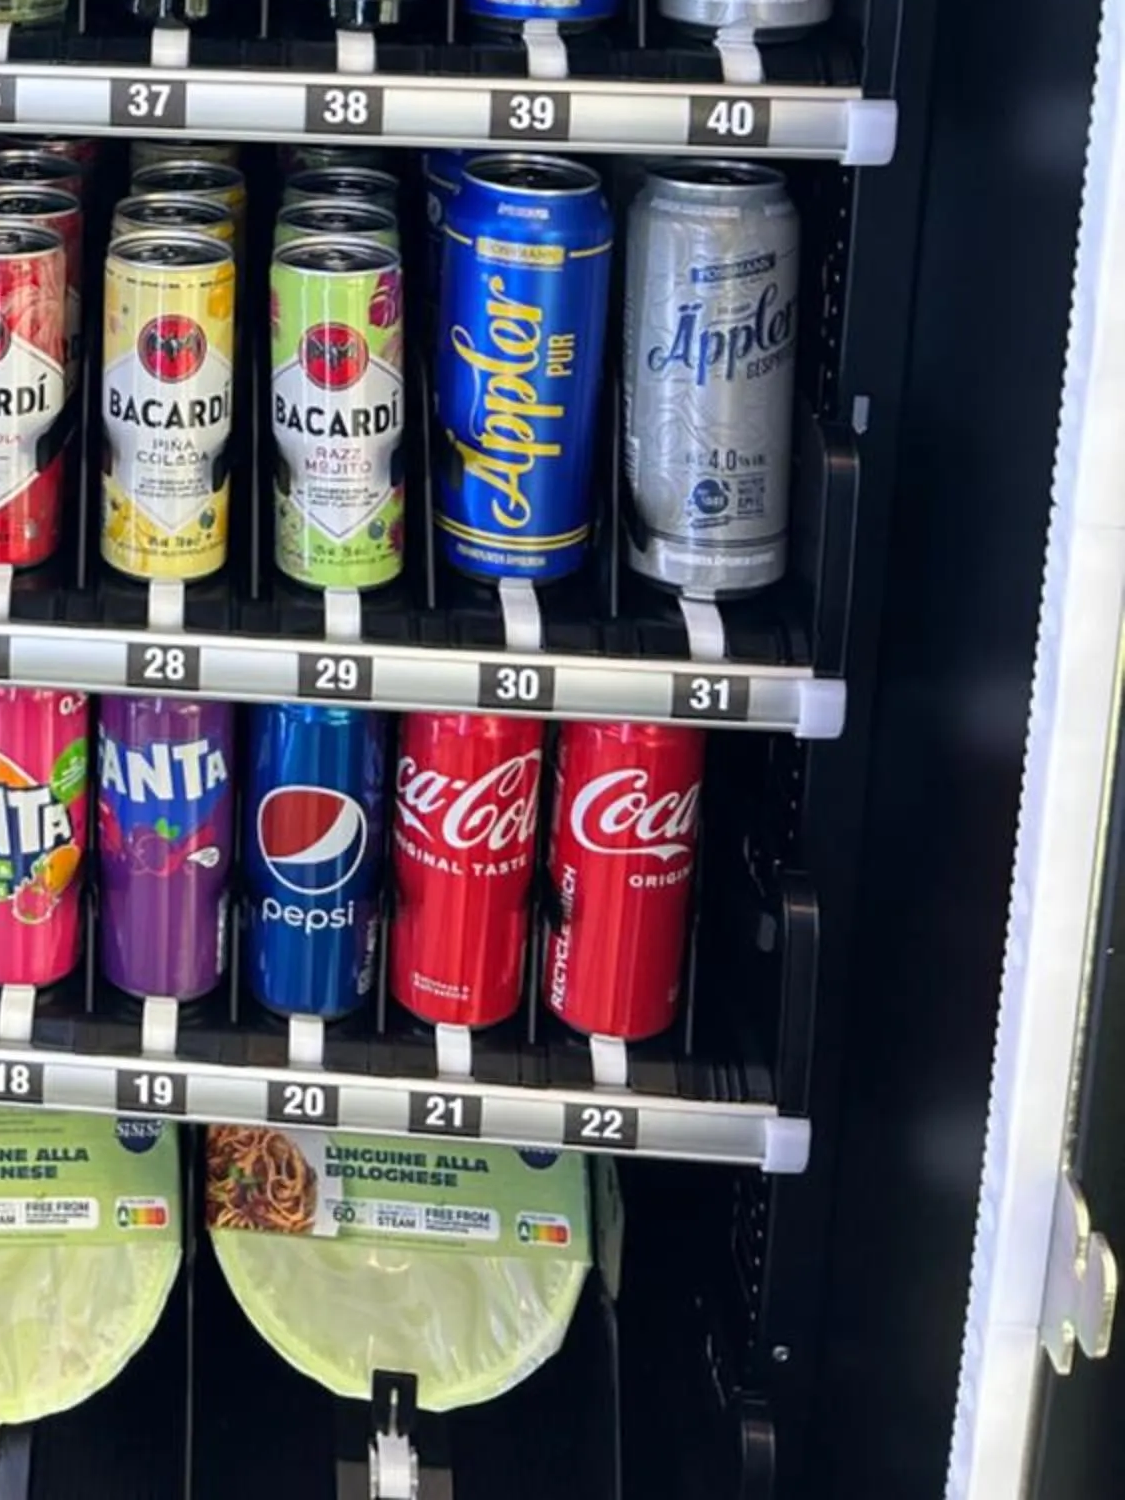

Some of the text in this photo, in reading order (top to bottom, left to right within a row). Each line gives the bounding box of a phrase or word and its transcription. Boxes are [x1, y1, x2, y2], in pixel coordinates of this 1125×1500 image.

[127, 82, 172, 117] 37
[323, 89, 368, 124] 38
[508, 94, 555, 130] 39
[706, 100, 755, 136] 40
[546, 332, 575, 378] PUR
[108, 380, 231, 430] BACARDÍ
[275, 390, 399, 438] BACARDÍ
[304, 457, 373, 475] MOJITO
[143, 646, 185, 681] 28
[315, 657, 358, 691] 29
[496, 667, 540, 701] 30
[689, 677, 730, 711] 31
[101, 738, 228, 803] ANTA
[261, 897, 355, 936] pepsi
[133, 1074, 173, 1106] 19
[283, 1084, 325, 1117] 20
[425, 1095, 463, 1127] 21
[581, 1107, 623, 1139] 22
[35, 1148, 90, 1163] ALLA
[324, 1145, 490, 1174] LINGUINE ALLA
[324, 1162, 460, 1188] BOLOGNESE
[26, 1200, 90, 1213] FREE FROM
[332, 1205, 356, 1223] 60
[378, 1215, 417, 1229] STEAM
[426, 1207, 491, 1224] FREE FROM
